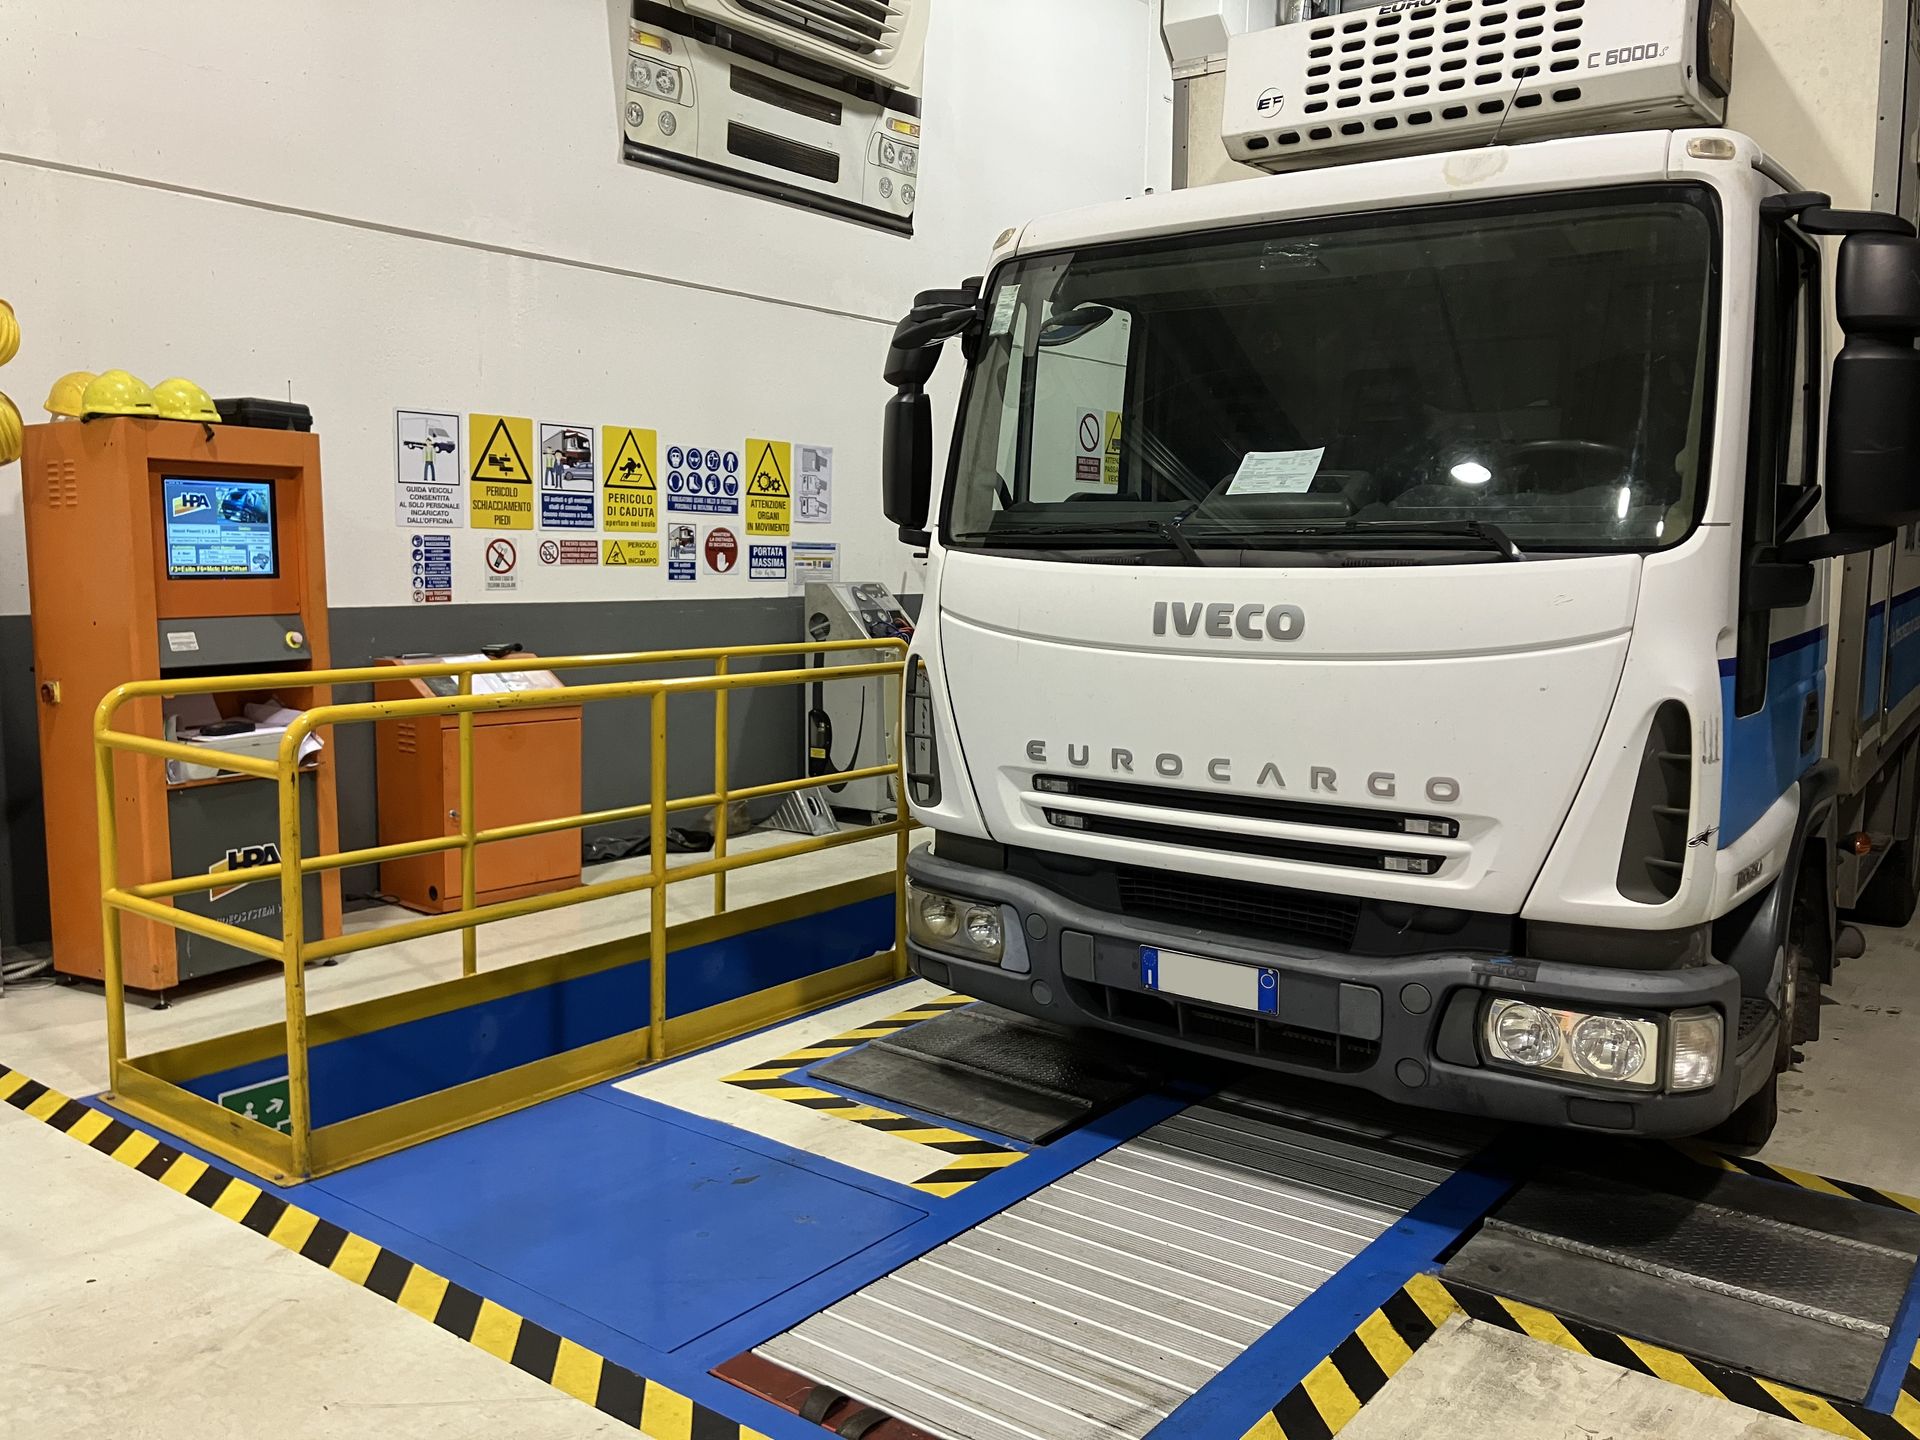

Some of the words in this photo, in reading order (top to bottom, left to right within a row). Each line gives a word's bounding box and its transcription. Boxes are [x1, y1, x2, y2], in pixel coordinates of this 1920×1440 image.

[1588, 52, 1601, 68] C
[486, 486, 518, 497] PERICOLO
[182, 494, 209, 507] HPA
[608, 493, 653, 505] PERICOLO
[751, 500, 786, 509] ATTENZIONE
[472, 500, 531, 512] SCHIACCIAMENTO
[607, 506, 616, 516] DI
[620, 506, 654, 517] CADUTA
[494, 515, 511, 525] PIEDI
[758, 511, 779, 520] ORGANI
[747, 522, 753, 530] IN
[755, 522, 789, 532] MOVIMENTO
[627, 541, 657, 549] PERICOLO
[753, 546, 783, 556] PORTATA
[752, 557, 785, 567] MASSIMA
[1152, 601, 1306, 641] IVECO
[1026, 739, 1460, 802] EUROCARGO
[228, 845, 281, 870] HPA
